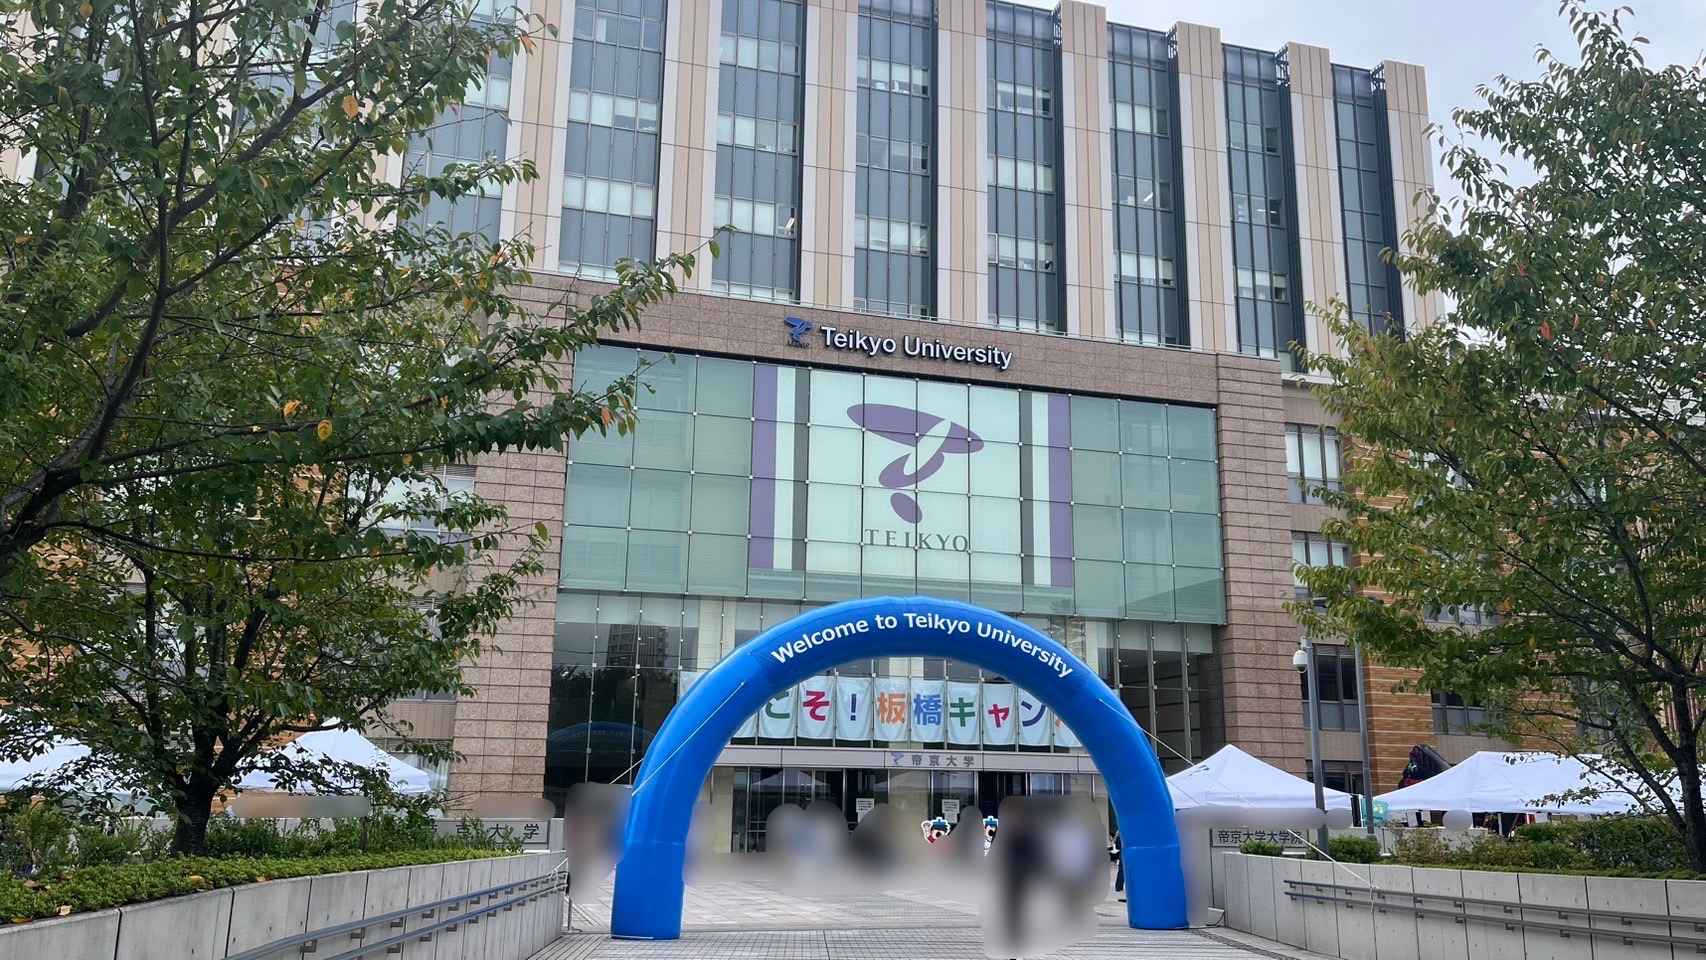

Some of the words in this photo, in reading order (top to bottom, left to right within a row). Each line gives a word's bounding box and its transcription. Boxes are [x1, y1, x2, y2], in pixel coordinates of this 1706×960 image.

[820, 326, 897, 355] Teikyo
[904, 336, 1013, 369] University
[865, 529, 969, 552] TEIKYO
[771, 618, 869, 663] Welcome
[875, 614, 898, 629] to
[904, 613, 970, 634] Teikyo
[977, 622, 1073, 678] University
[765, 690, 1062, 729] こそ!板橋キャン
[911, 754, 975, 767] 帝京大学
[1218, 830, 1302, 844] 帝京大学大学院
